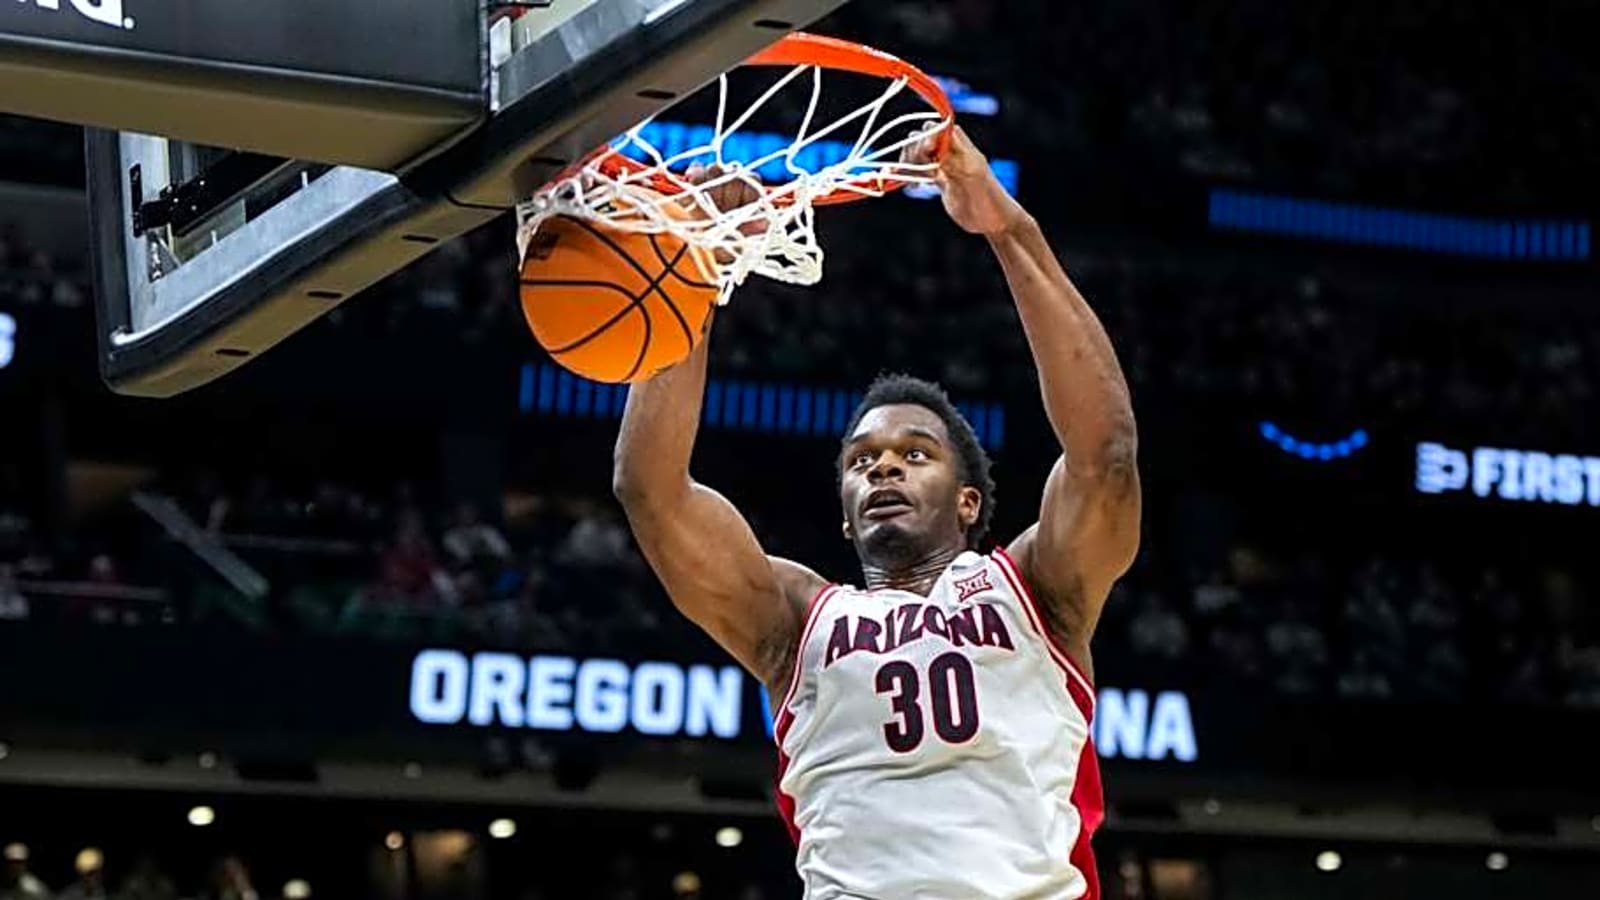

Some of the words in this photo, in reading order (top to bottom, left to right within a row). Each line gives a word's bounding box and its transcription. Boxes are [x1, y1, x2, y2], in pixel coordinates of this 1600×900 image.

[1472, 446, 1600, 507] FIRST
[825, 603, 1015, 669] ARIZONA
[410, 649, 743, 738] OREGON
[875, 652, 980, 753] 30
